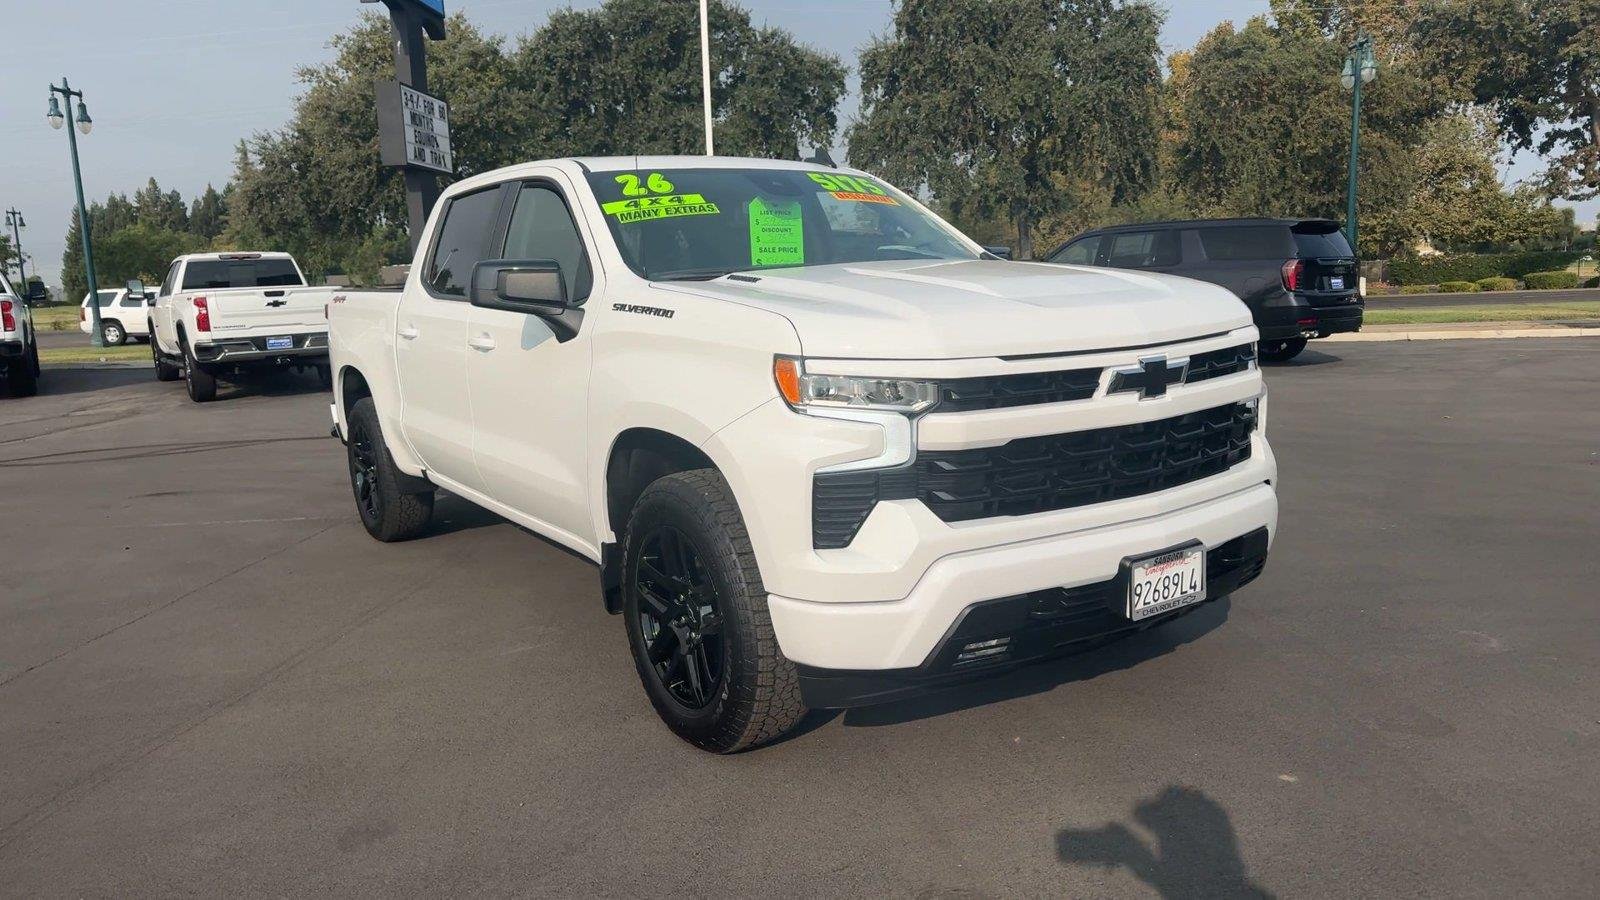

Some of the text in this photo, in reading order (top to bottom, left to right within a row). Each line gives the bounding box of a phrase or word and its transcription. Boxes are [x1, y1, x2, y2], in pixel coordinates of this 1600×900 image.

[413, 145, 426, 162] AND
[614, 172, 675, 197] 26
[620, 203, 715, 222] MANY EXTRAS
[778, 246, 799, 254] PRICE
[612, 302, 675, 319] SILVERADO
[1153, 550, 1185, 566] SANBORN
[1134, 567, 1197, 608] 92689L4
[1142, 599, 1181, 617] CHEVROLET
